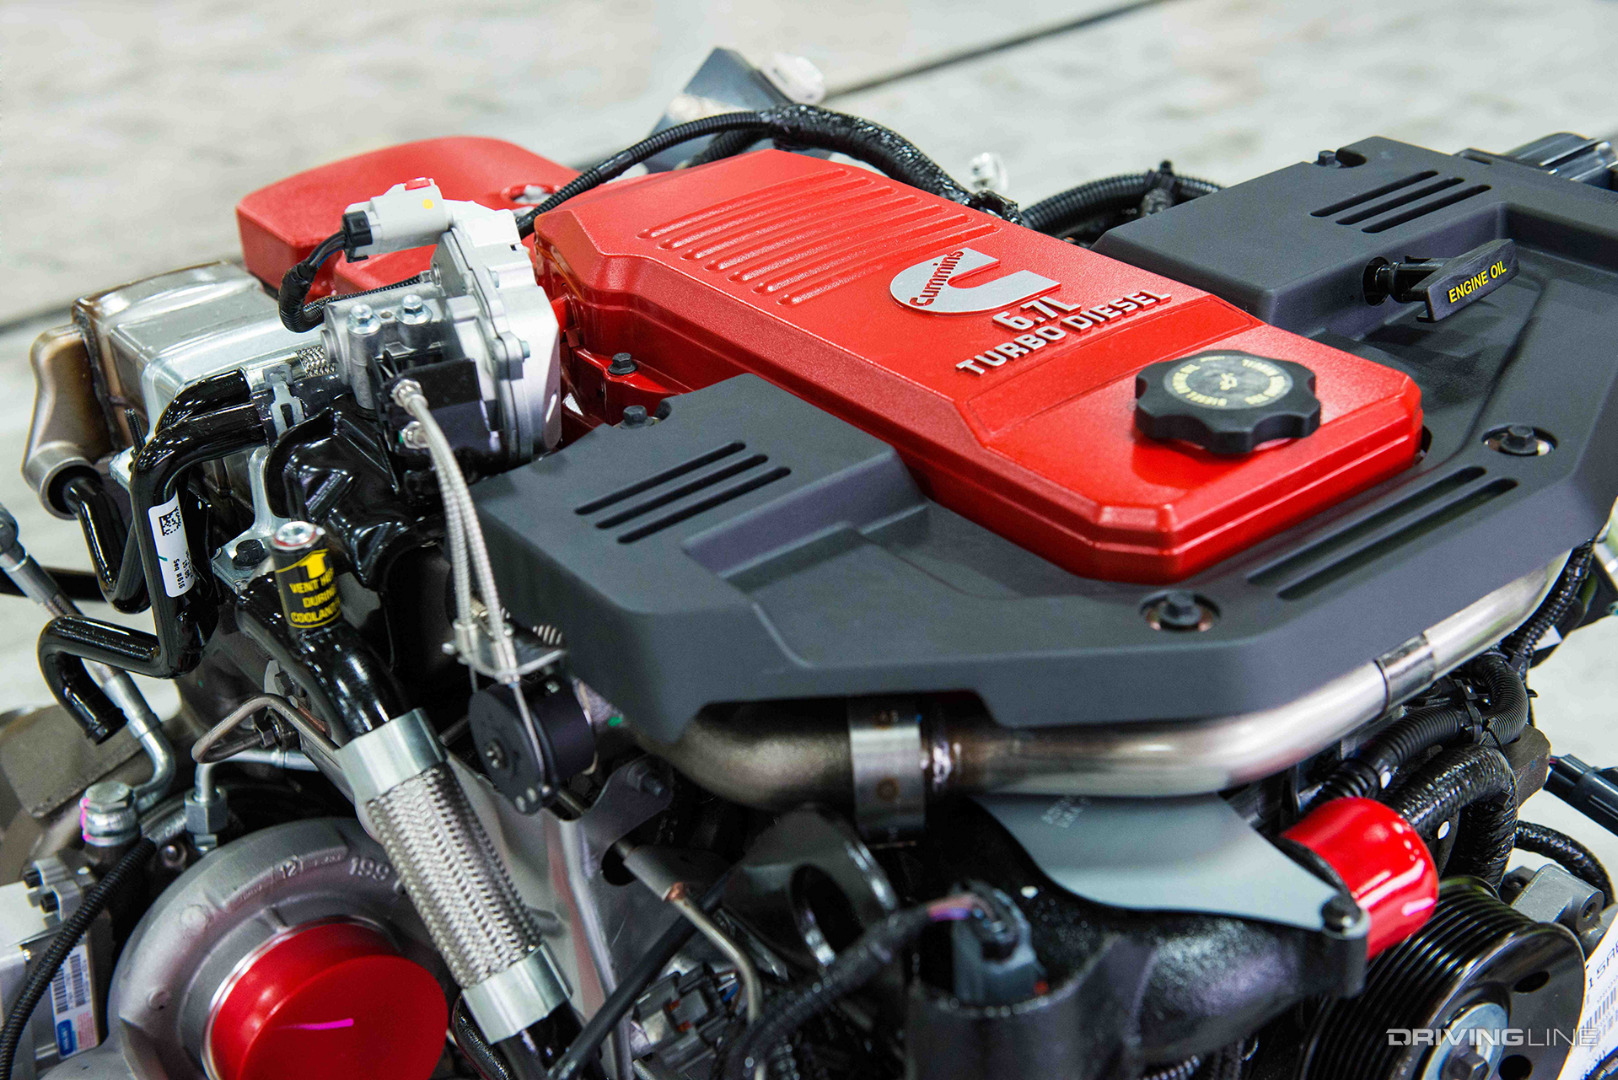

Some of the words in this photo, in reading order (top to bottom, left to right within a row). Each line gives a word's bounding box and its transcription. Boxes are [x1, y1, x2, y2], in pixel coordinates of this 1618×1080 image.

[909, 249, 965, 307] Cummins
[1448, 271, 1488, 303] ENGINE
[1490, 261, 1507, 279] OIL
[954, 325, 1067, 377] TURBO
[1059, 288, 1173, 334] DIESEL
[991, 295, 1082, 333] 6.7L
[288, 579, 320, 594] VENT
